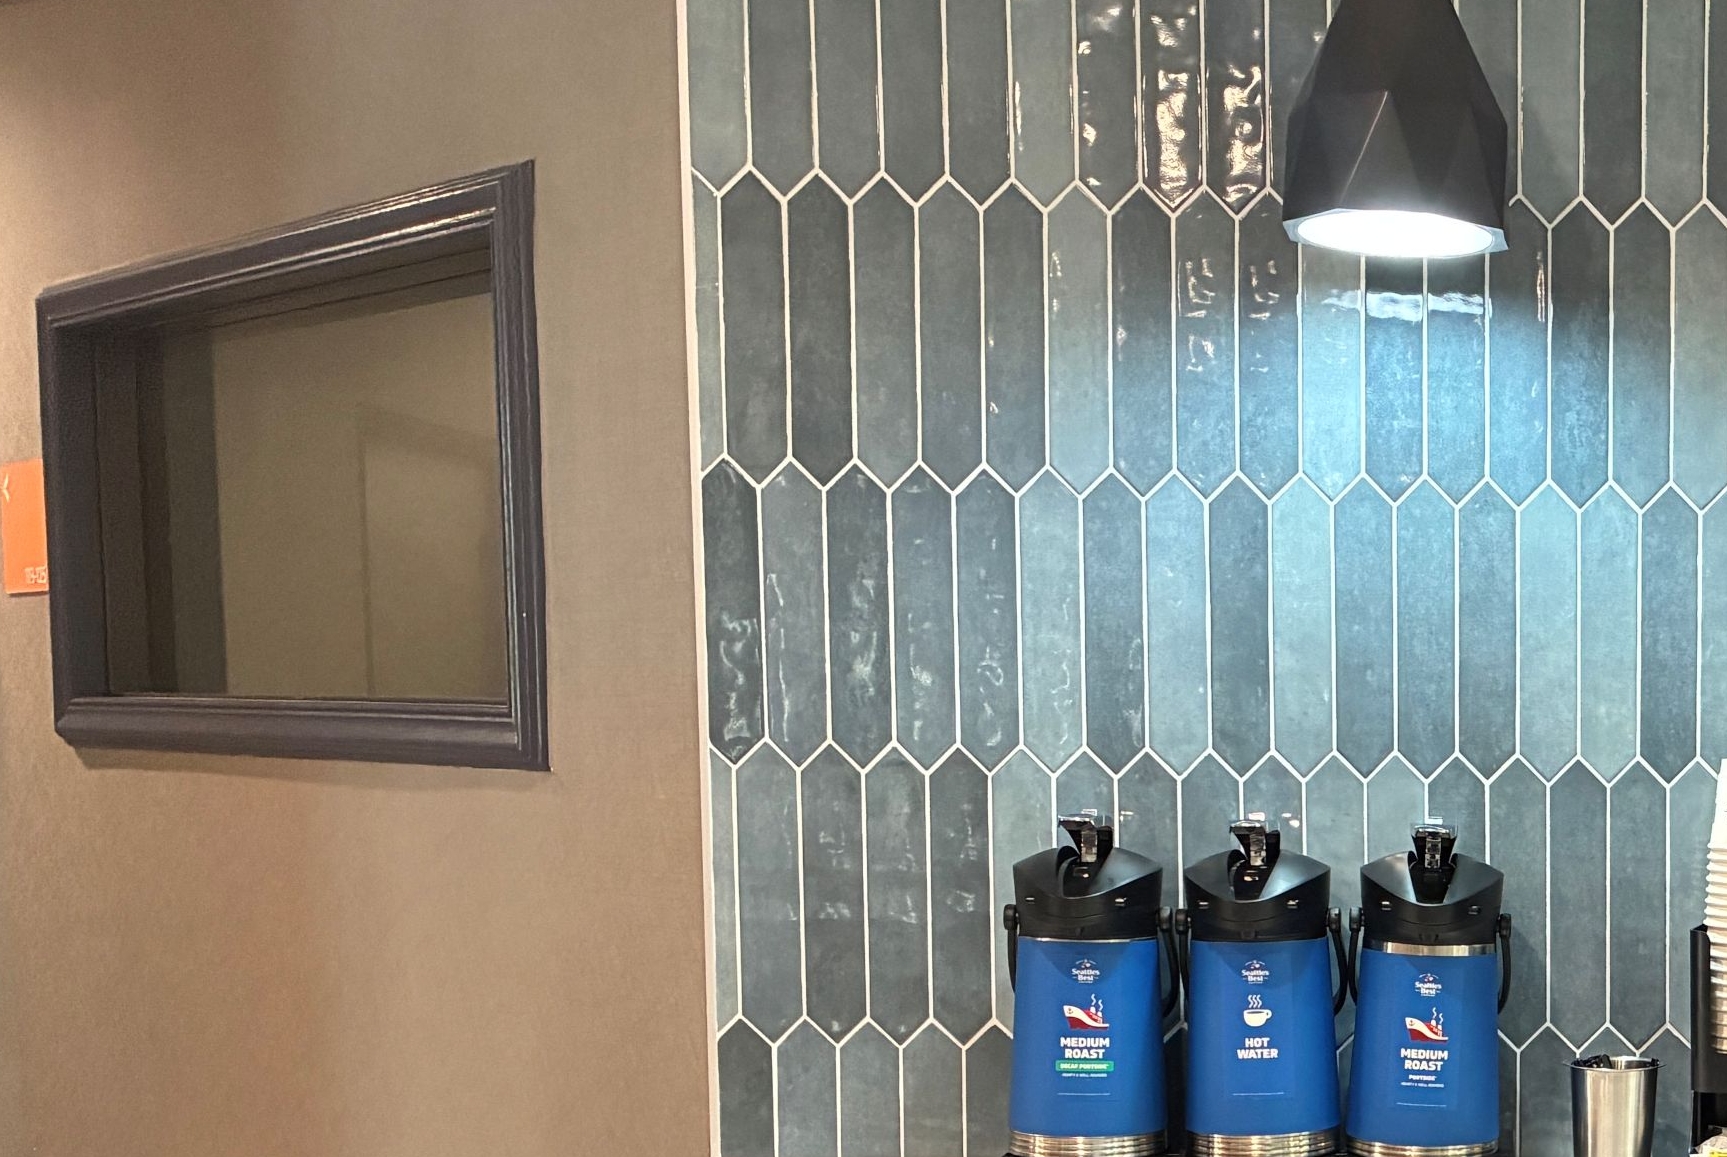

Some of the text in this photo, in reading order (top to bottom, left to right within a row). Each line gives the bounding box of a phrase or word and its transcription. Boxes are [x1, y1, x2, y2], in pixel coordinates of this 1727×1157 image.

[1060, 1036, 1110, 1048] MEDIUM
[1244, 1037, 1270, 1048] HOT
[1064, 1048, 1105, 1059] ROAST
[1236, 1048, 1279, 1059] WATER
[1400, 1048, 1448, 1060] MEDIUM
[1404, 1060, 1443, 1071] ROAST
